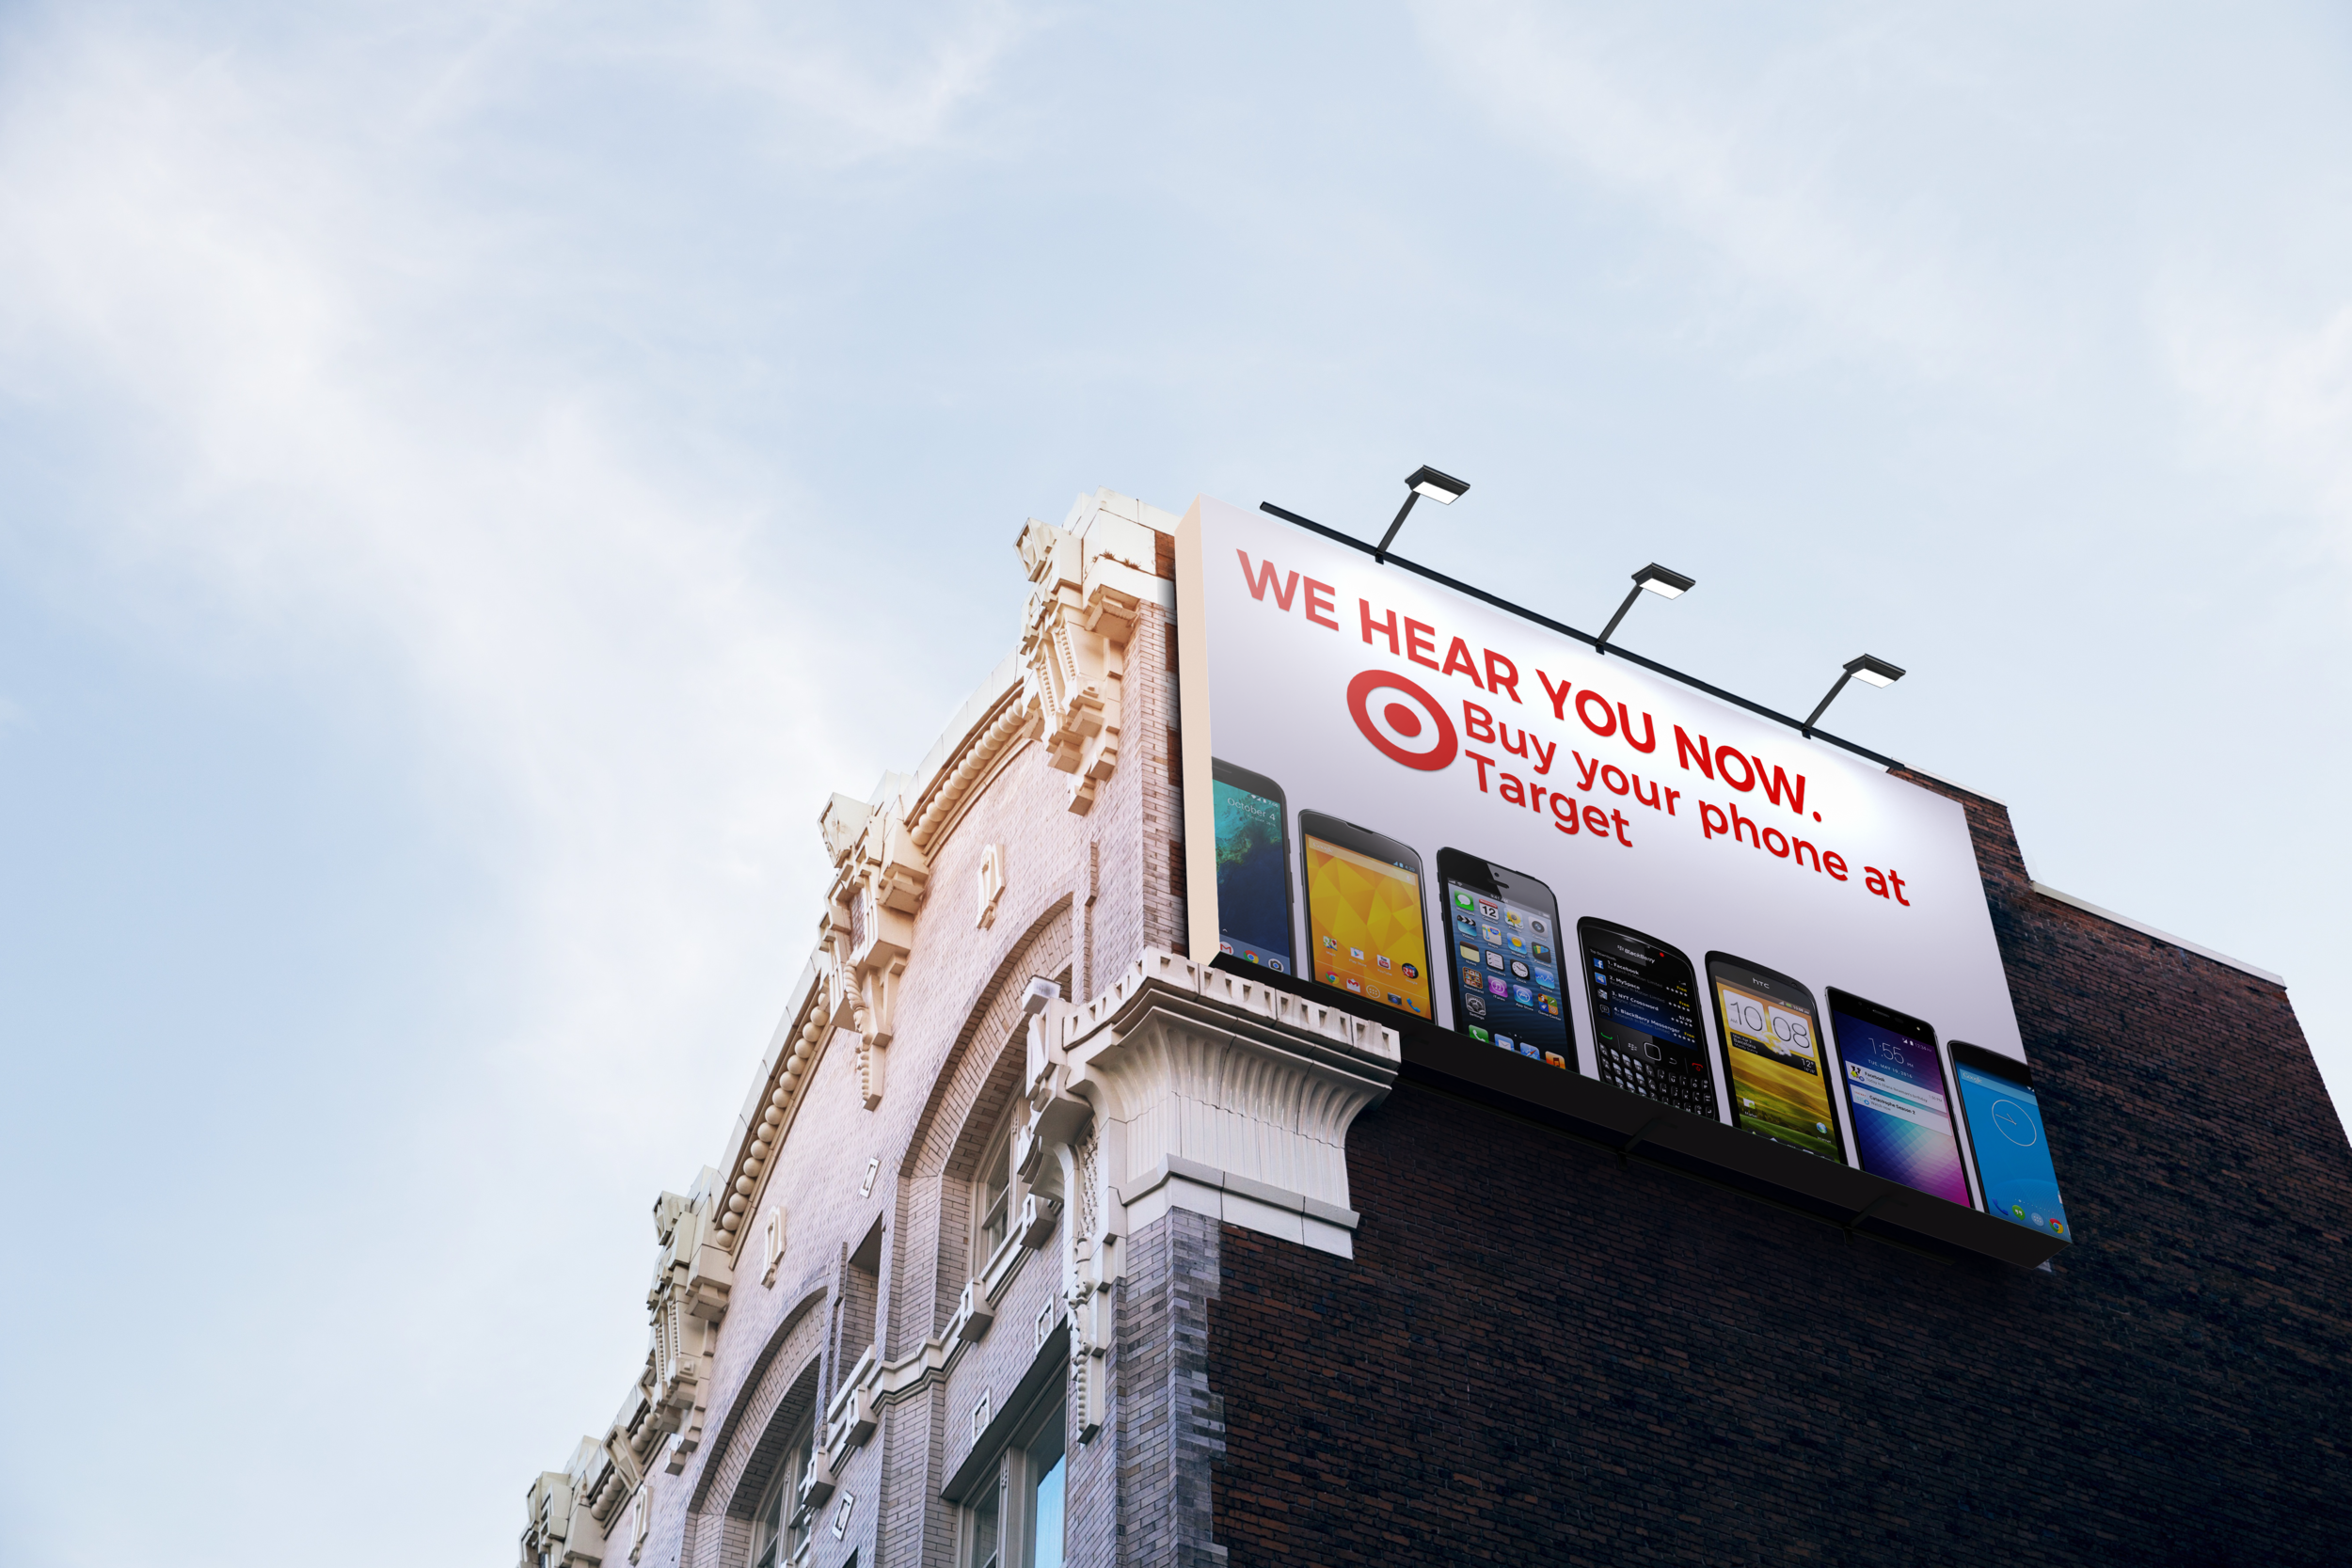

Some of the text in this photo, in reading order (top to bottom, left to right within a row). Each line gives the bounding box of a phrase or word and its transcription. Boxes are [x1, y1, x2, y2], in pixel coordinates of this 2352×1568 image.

[1237, 549, 1821, 823] WE HEAR YOU NOW.
[1227, 797, 1267, 817] October
[1269, 813, 1276, 821] 4
[1463, 700, 1909, 904] Buy your phone at
[1465, 750, 1632, 847] Target
[1312, 841, 1334, 853] Google
[1482, 905, 1497, 918] 12
[1624, 948, 1656, 964] BlackBerry
[1613, 962, 1640, 975] Facebook
[1615, 977, 1641, 990] MySpace
[1618, 992, 1629, 1001] NYT
[1629, 997, 1660, 1011] Crossword
[1620, 1008, 1650, 1023] BlackBerry
[1650, 1019, 1680, 1034] Messenger
[1730, 1001, 1810, 1049] 10 08
[1867, 1037, 1905, 1065] 1:55
[1963, 1072, 1983, 1084] Google
